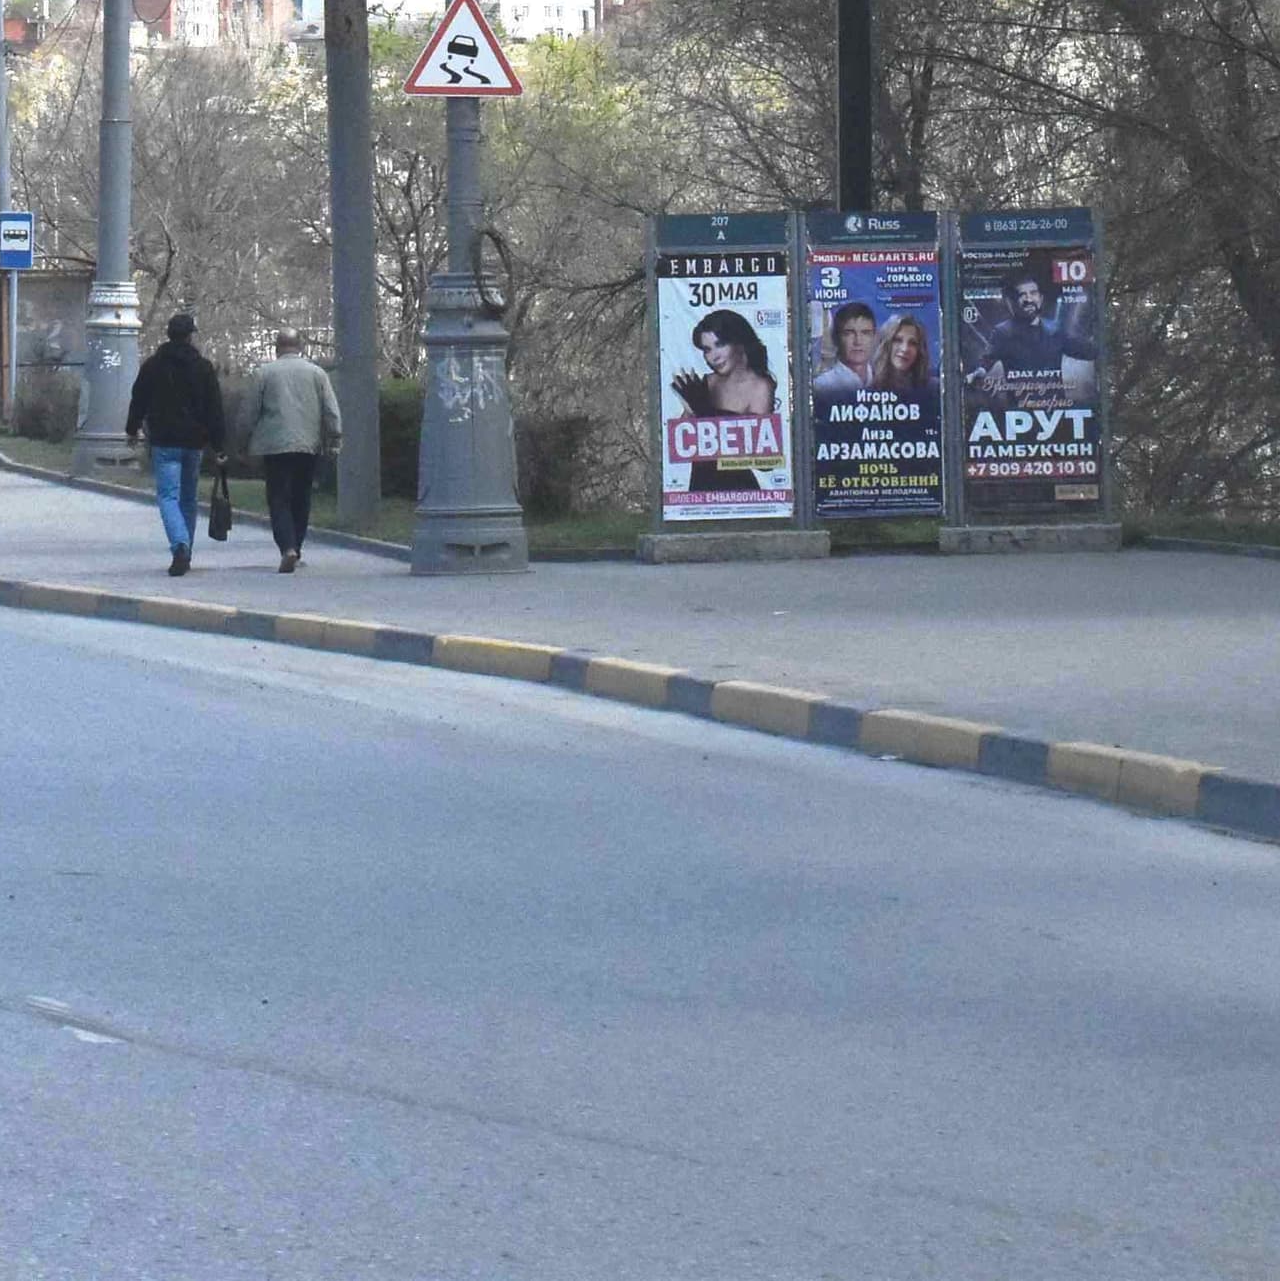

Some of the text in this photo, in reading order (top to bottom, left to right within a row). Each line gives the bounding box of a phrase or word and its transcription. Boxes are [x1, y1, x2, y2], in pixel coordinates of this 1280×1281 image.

[712, 217, 729, 226] 207
[868, 218, 900, 230] Russ
[985, 222, 991, 231] 8
[993, 220, 1017, 231] (863)
[853, 252, 934, 262] MEGAARTS.RU
[670, 257, 776, 275] EMBARGO
[1057, 260, 1086, 281] 10
[821, 267, 840, 288] 3
[887, 274, 933, 282] ГОРЬКОГО
[689, 282, 758, 307] 30 МАЯ
[815, 289, 847, 299] ИЮНЯ
[1007, 369, 1062, 379] ДЗАХ АРУТ
[857, 389, 898, 404] Игорь
[829, 404, 920, 422] ЛИФАНОВ
[968, 409, 1093, 442] АРУТ
[675, 418, 779, 458] СВЕТА
[862, 427, 894, 440] Лиза
[817, 441, 940, 460] АРЗАМАСОВА
[969, 443, 1093, 458] ПАМБУКЧЯН
[859, 463, 898, 474] НОЧЬ
[968, 461, 1096, 476] +7 909 420 10 10
[819, 473, 939, 488] ЕЁ ОТКРОВЕНИЙ
